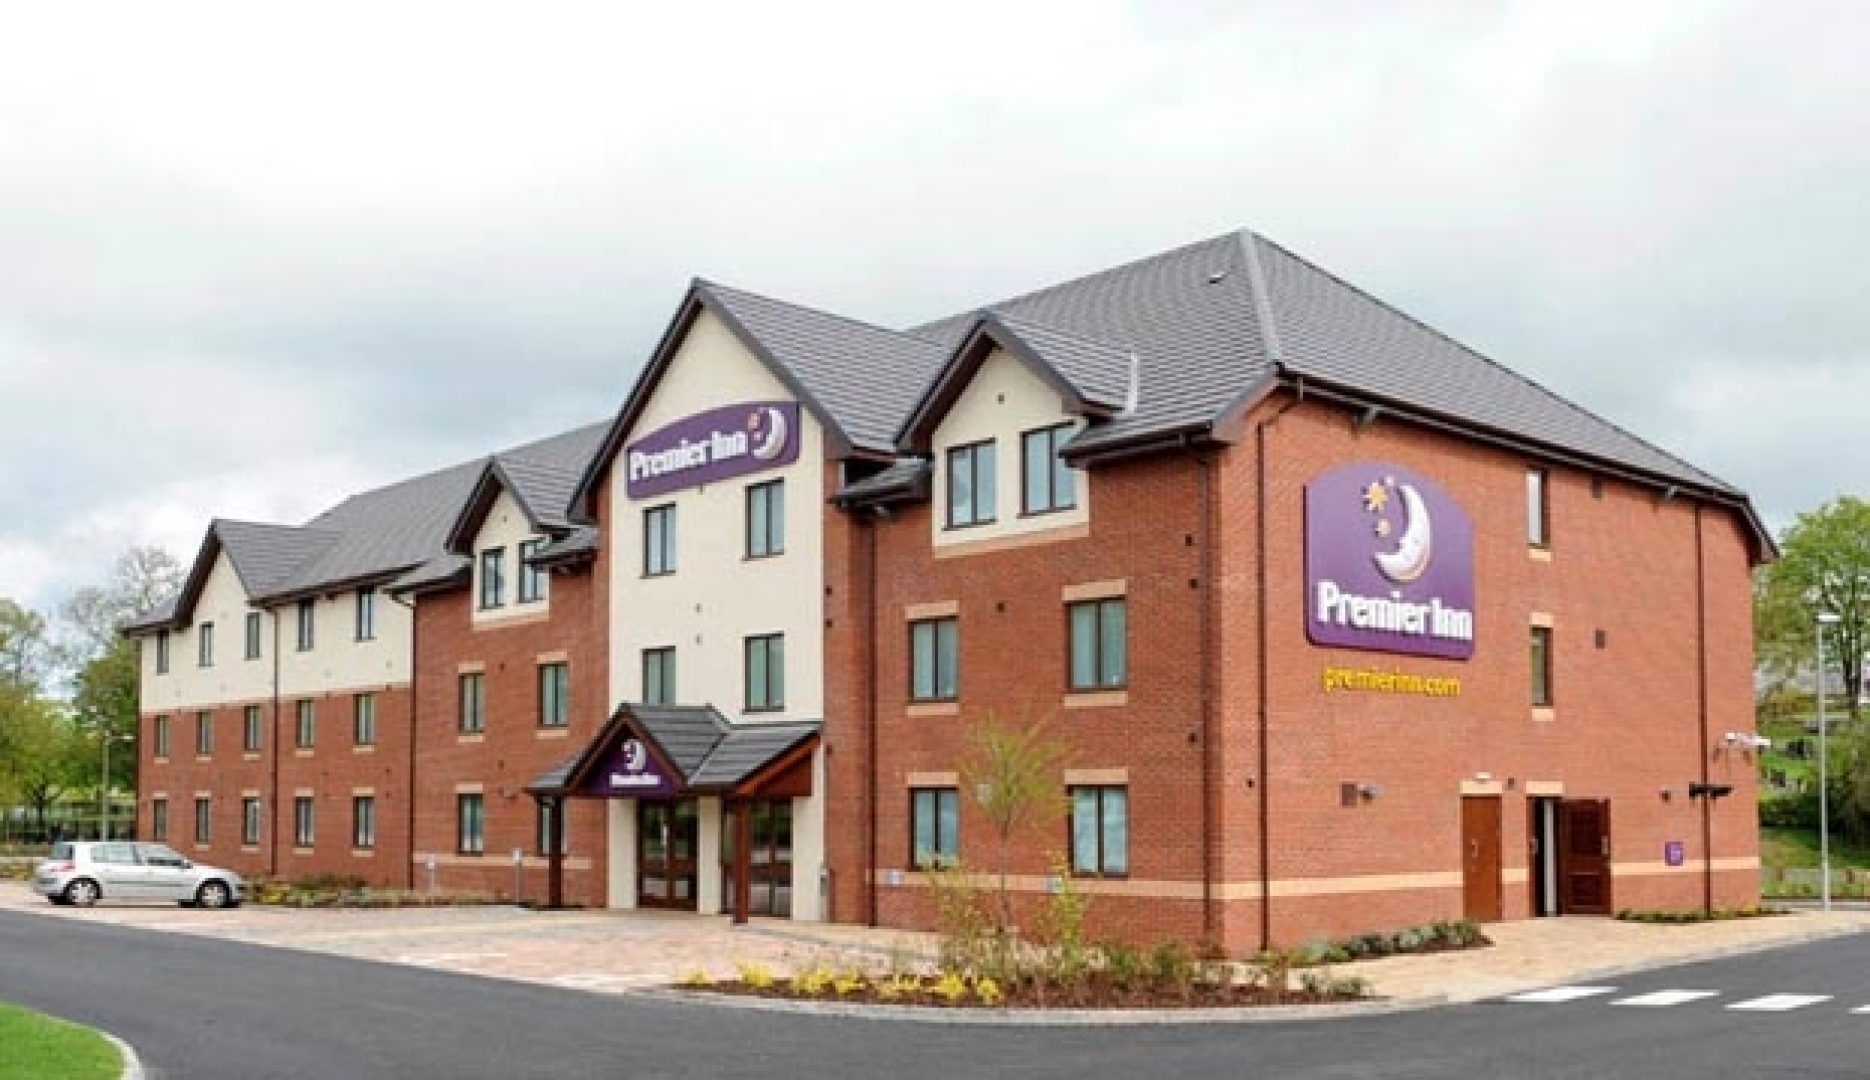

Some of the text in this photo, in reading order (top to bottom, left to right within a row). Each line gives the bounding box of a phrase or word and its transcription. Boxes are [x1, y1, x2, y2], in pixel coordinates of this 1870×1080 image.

[629, 431, 747, 481] Premier Inn
[1317, 579, 1473, 640] Premier Inn
[1325, 666, 1461, 697] premierinn.com
